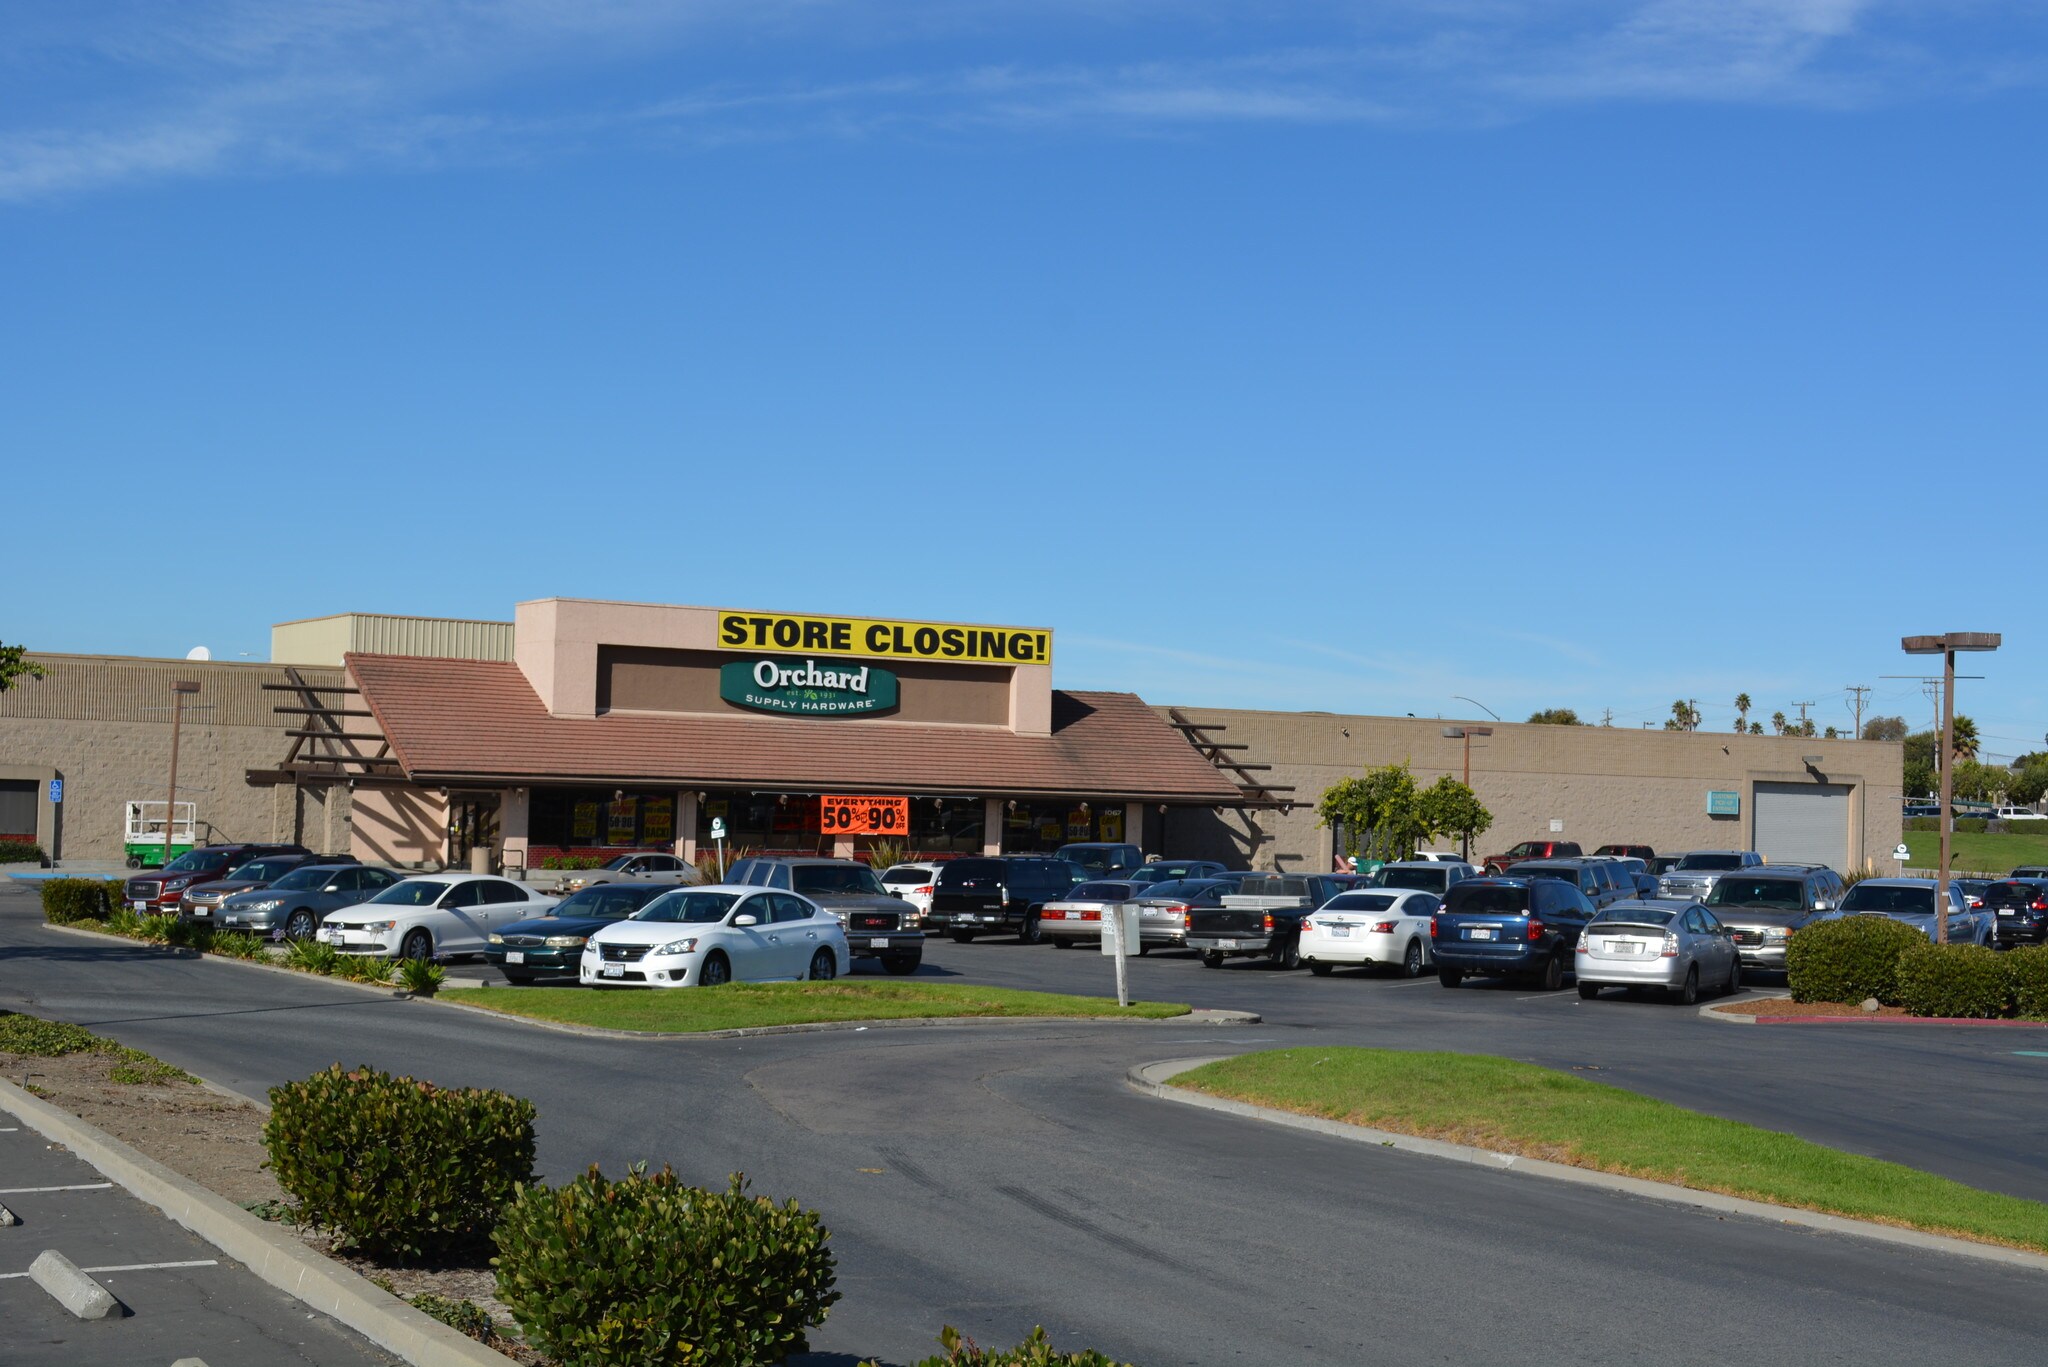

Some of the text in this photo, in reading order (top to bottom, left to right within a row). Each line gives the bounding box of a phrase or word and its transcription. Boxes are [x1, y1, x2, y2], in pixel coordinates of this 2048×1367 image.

[722, 615, 1046, 661] STORE CLOSING!
[753, 660, 868, 693] Orchard
[745, 694, 797, 709] SUPPLY
[828, 798, 902, 806] EVERYTHING
